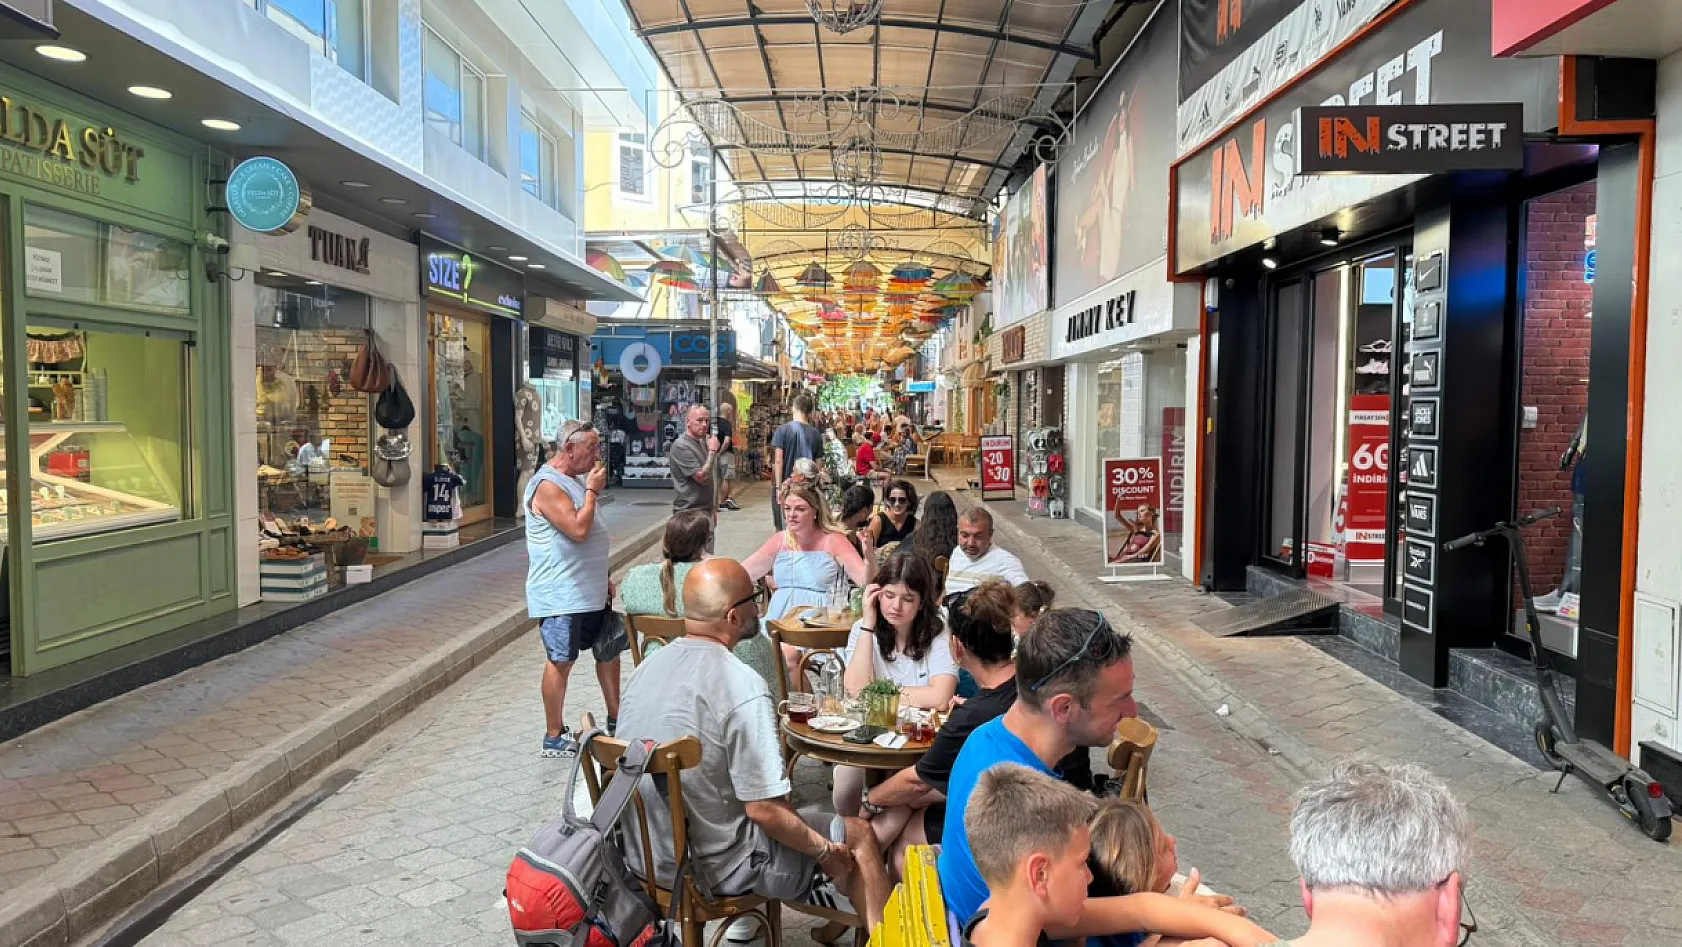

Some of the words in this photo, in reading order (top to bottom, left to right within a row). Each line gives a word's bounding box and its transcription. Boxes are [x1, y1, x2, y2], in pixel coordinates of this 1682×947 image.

[79, 126, 145, 184] SÜT
[1319, 117, 1380, 158] IN
[1387, 122, 1507, 150] STREET
[1, 147, 100, 195] PATISSERIE
[1210, 118, 1266, 245] IN
[1066, 304, 1103, 343] JIMMY
[1105, 290, 1137, 331] KEY
[433, 483, 450, 501] 14
[1112, 467, 1154, 484] 30%
[1112, 485, 1155, 495] DISCOUNT
[1353, 472, 1388, 484] İNDİRİ
